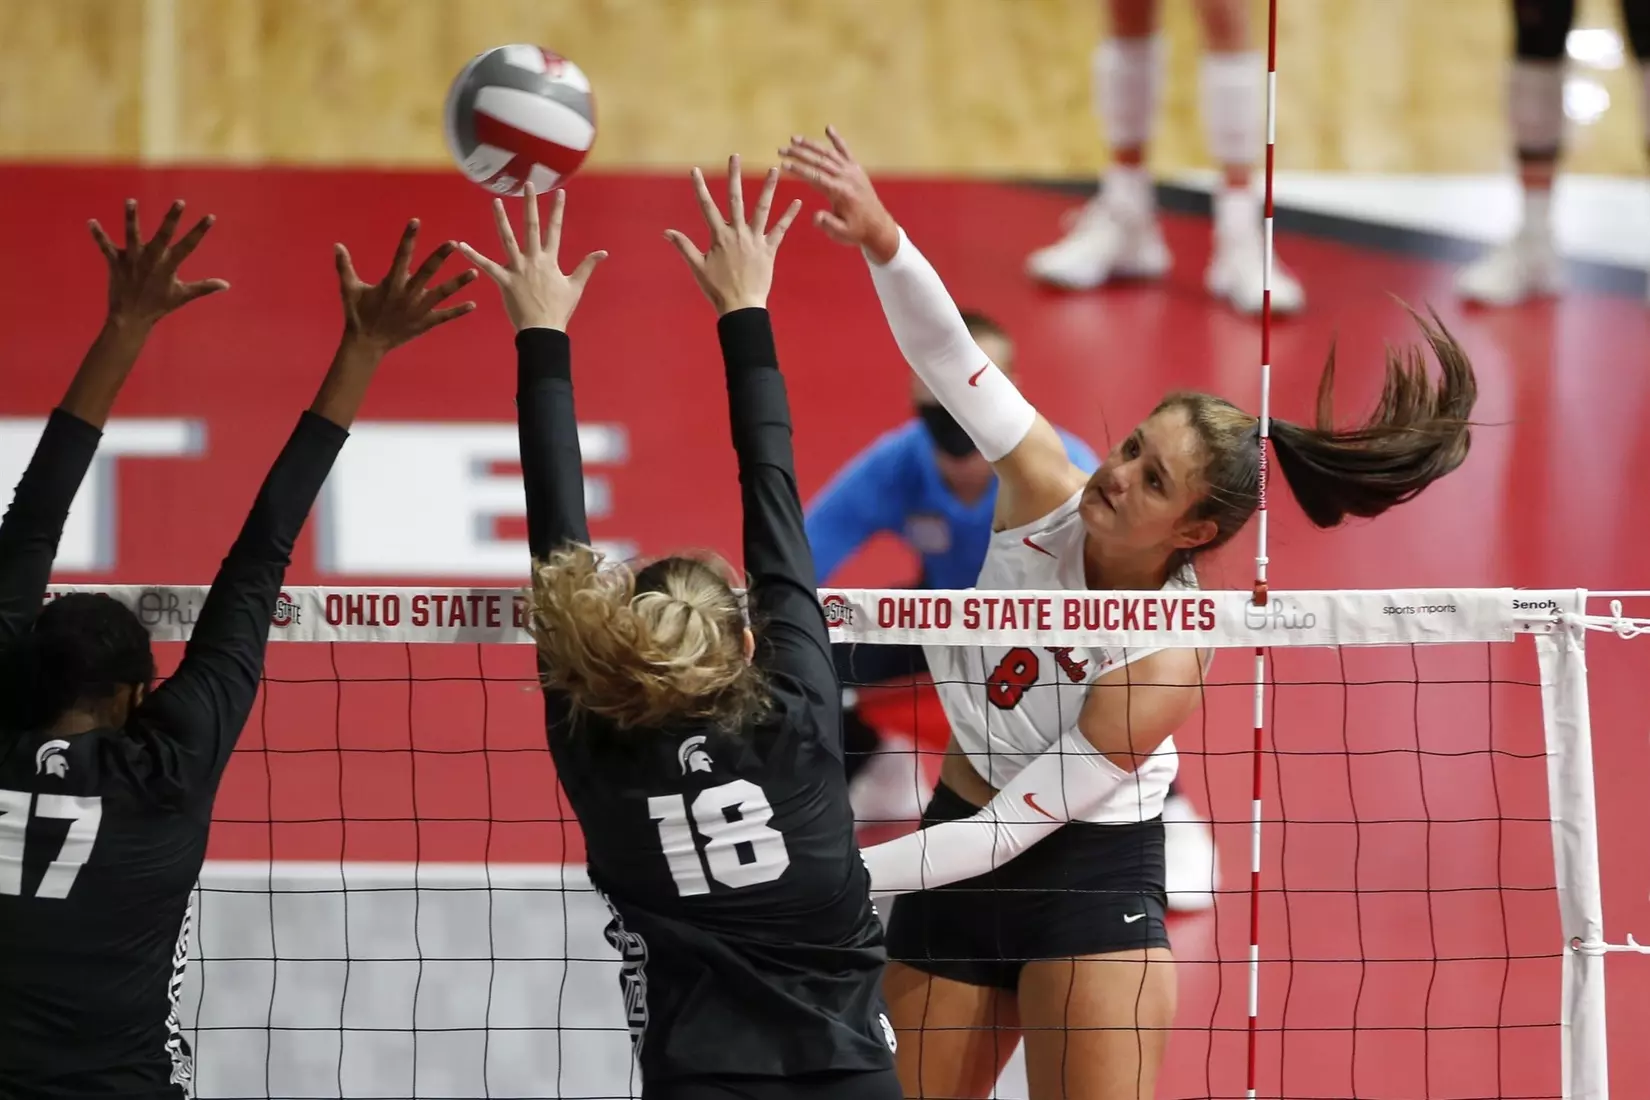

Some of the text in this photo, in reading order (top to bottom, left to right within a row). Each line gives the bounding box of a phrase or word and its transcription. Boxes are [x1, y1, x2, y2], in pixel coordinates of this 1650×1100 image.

[138, 591, 198, 626] Ohi
[325, 593, 401, 627] OHIO
[411, 594, 501, 628] STATE
[877, 597, 1216, 631] OHIO STATE BUCKEYES
[1244, 597, 1316, 631] Ohio
[1382, 603, 1457, 616] sports imports
[1512, 599, 1557, 610] Senoh
[987, 646, 1040, 710] 8
[0, 788, 103, 899] 17
[647, 778, 791, 898] 18
